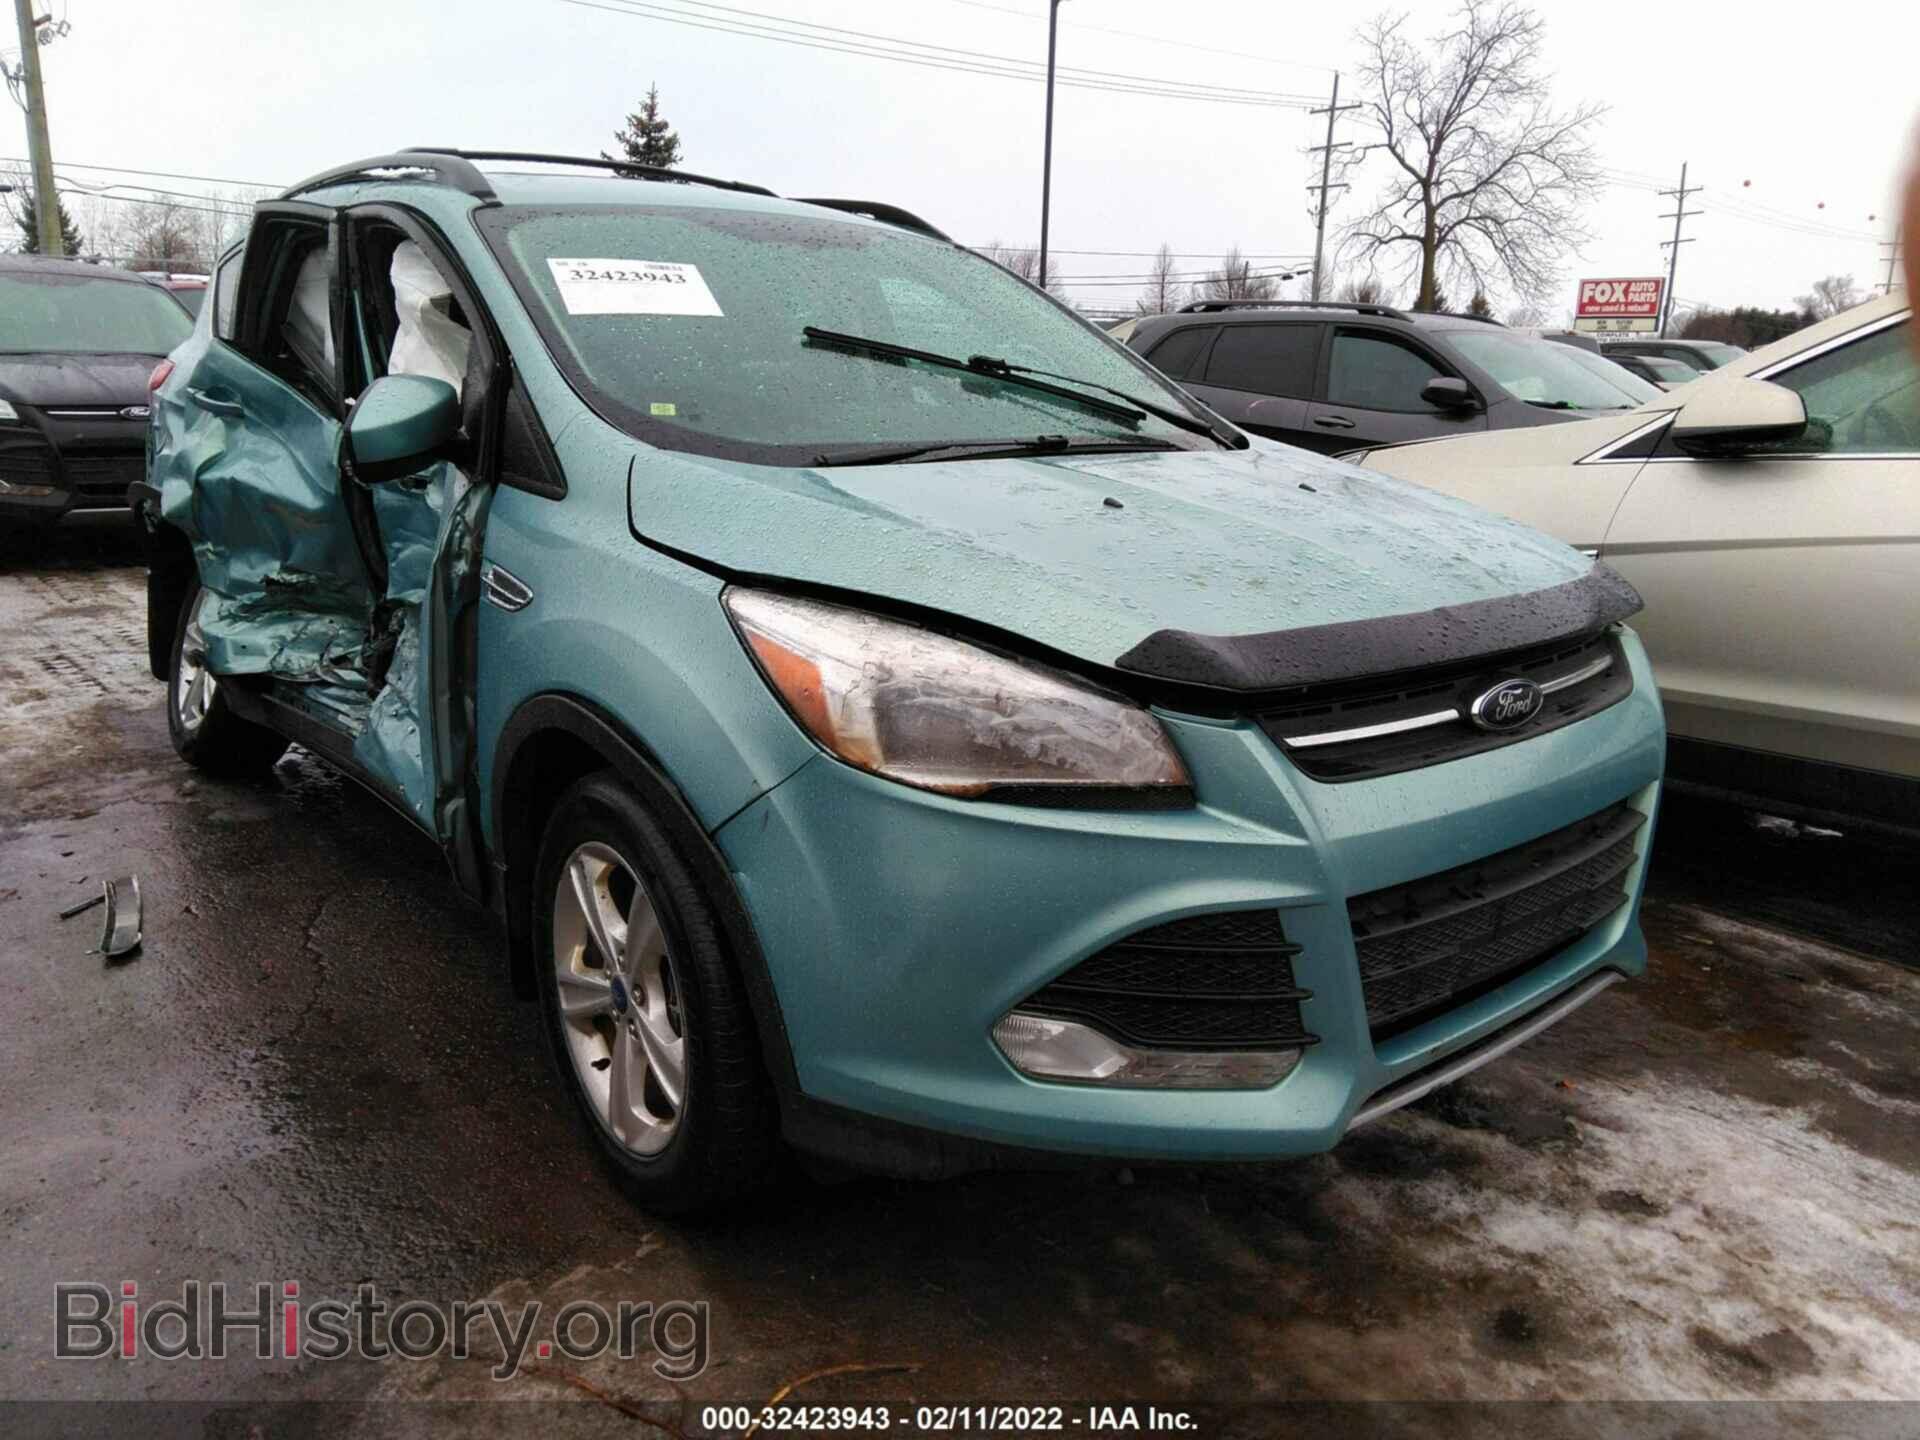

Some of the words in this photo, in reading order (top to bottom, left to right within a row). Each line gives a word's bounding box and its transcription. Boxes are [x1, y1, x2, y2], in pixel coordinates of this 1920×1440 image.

[570, 270, 687, 283] 32423943
[1582, 282, 1627, 303] FOX
[1629, 281, 1655, 291] AUTO
[1628, 292, 1657, 302] PARTS
[1496, 688, 1533, 720] Ford
